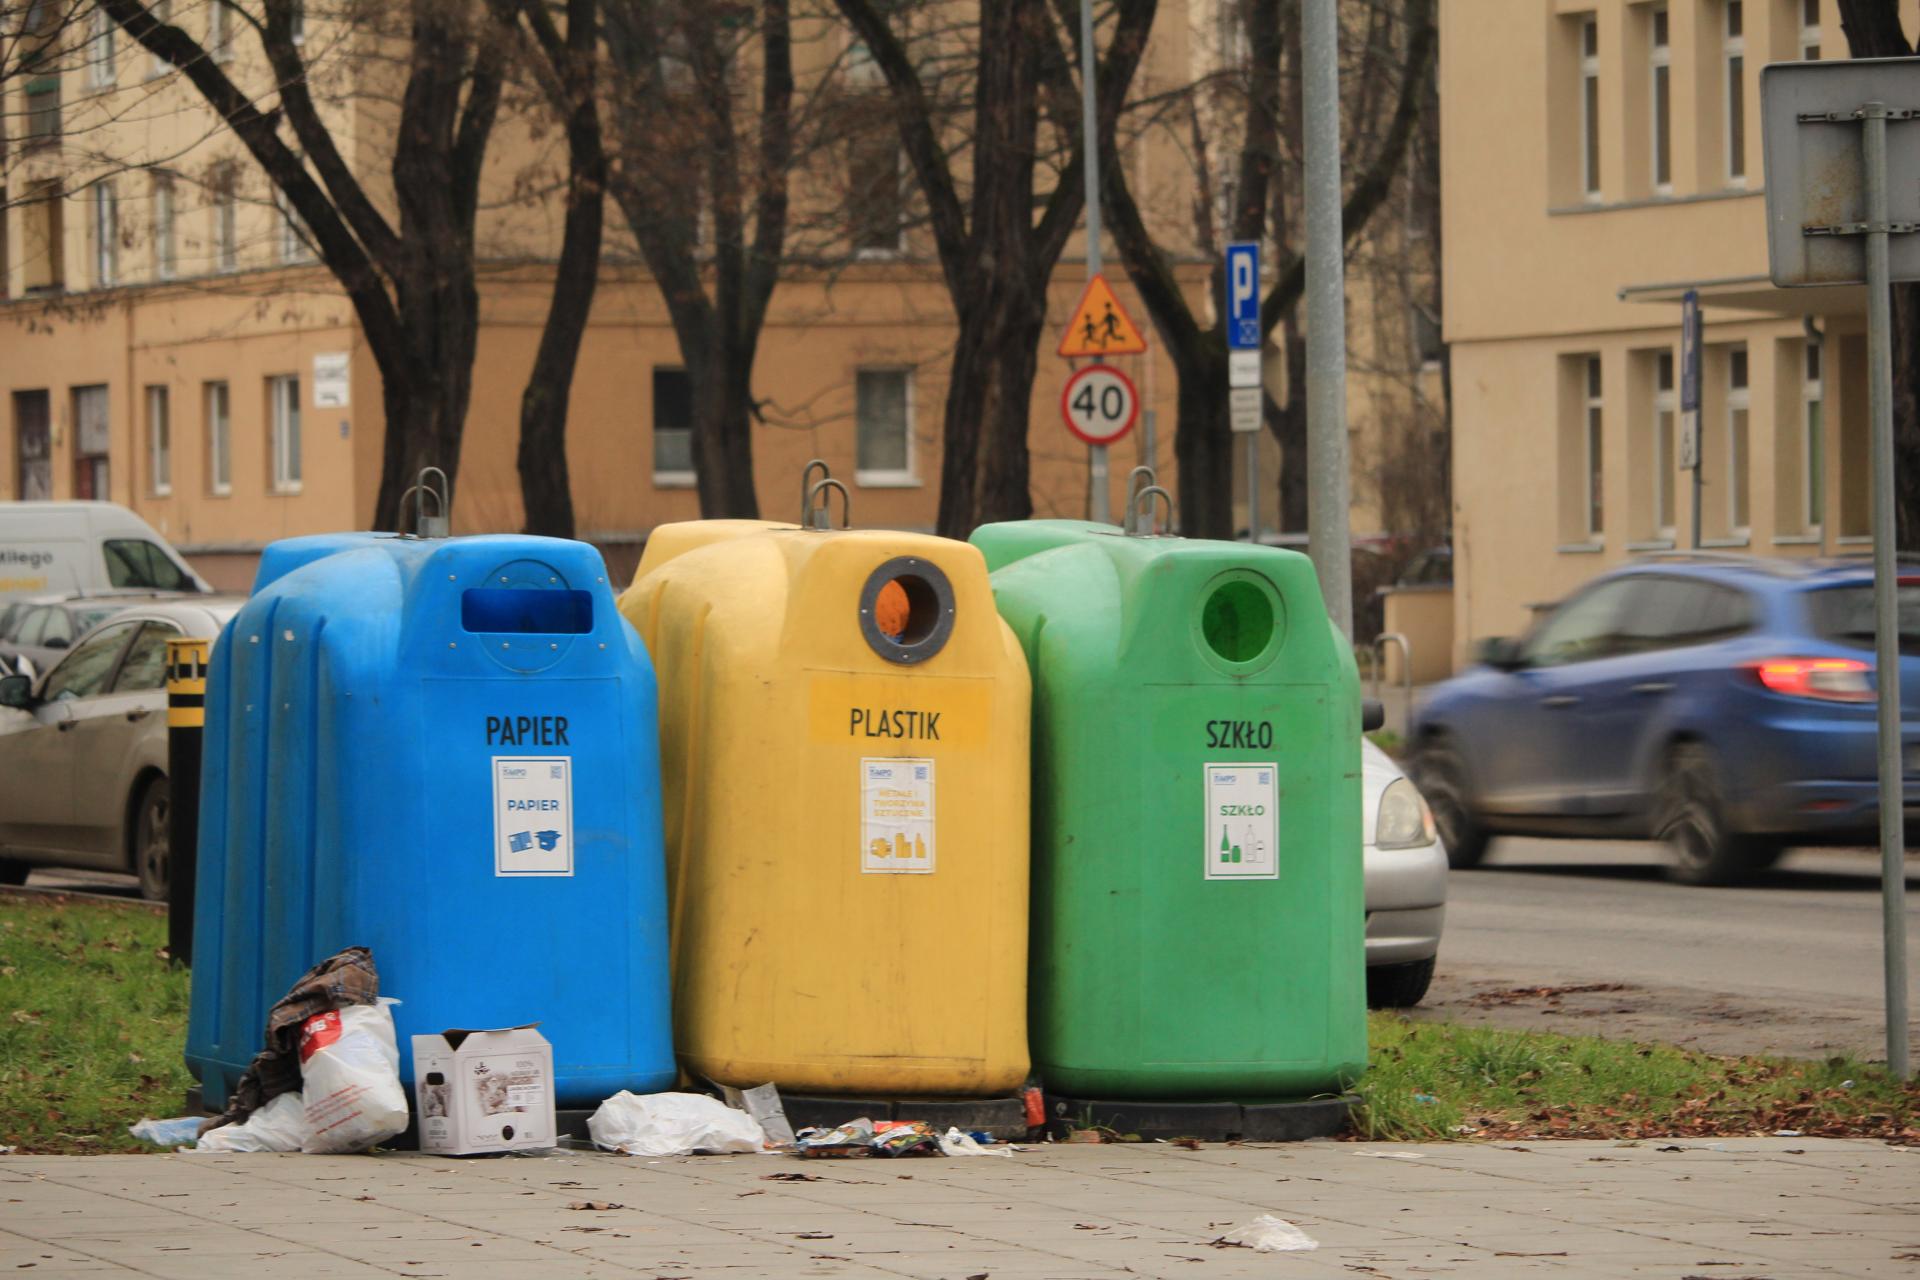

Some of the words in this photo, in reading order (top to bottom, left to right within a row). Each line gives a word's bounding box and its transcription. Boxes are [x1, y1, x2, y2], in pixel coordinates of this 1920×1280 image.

[1231, 251, 1253, 319] P
[1072, 384, 1124, 421] 40
[487, 716, 569, 746] PAPIER
[849, 708, 941, 740] PLASTIK
[1206, 720, 1273, 749] SZKŁO
[507, 799, 560, 812] PAPIER
[1219, 805, 1266, 816] SZKŁO
